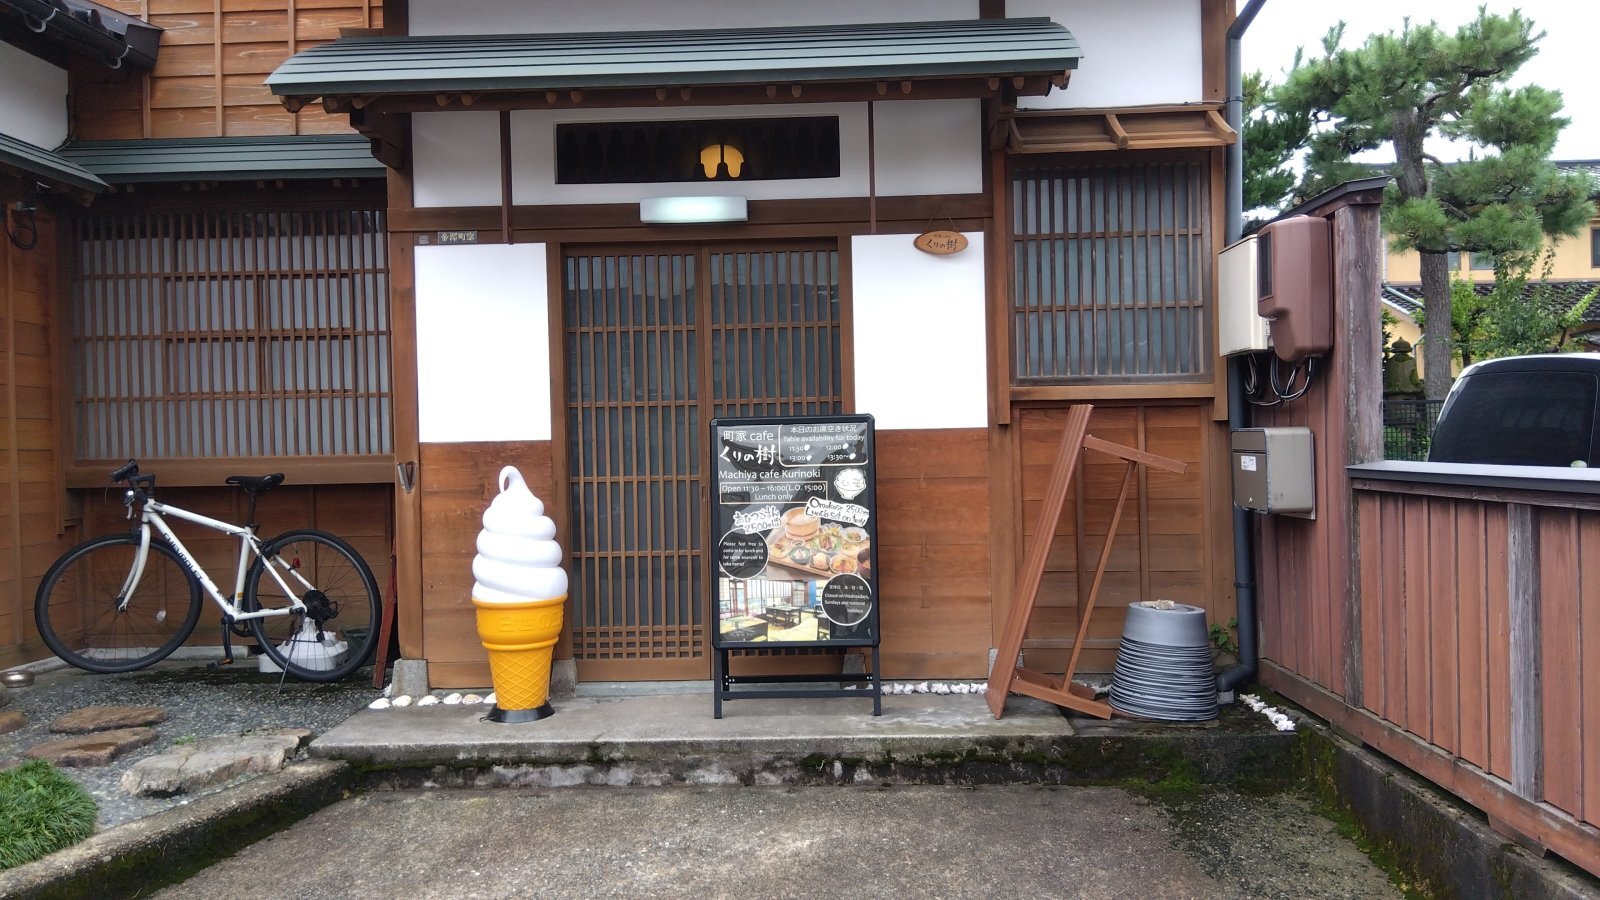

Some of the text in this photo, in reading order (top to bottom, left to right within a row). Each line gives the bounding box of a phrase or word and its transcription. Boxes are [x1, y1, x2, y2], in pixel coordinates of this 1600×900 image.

[927, 238, 958, 250] くりの樹
[723, 430, 774, 442] 町家 cafe
[783, 434, 865, 443] Table availability for today
[788, 445, 804, 453] 11:30
[720, 444, 777, 466] くりの樹
[719, 469, 821, 480] Machiya cafe Kurinoki
[722, 485, 742, 493] Open
[743, 485, 760, 493] 11:30
[754, 493, 794, 501] Lunch only
